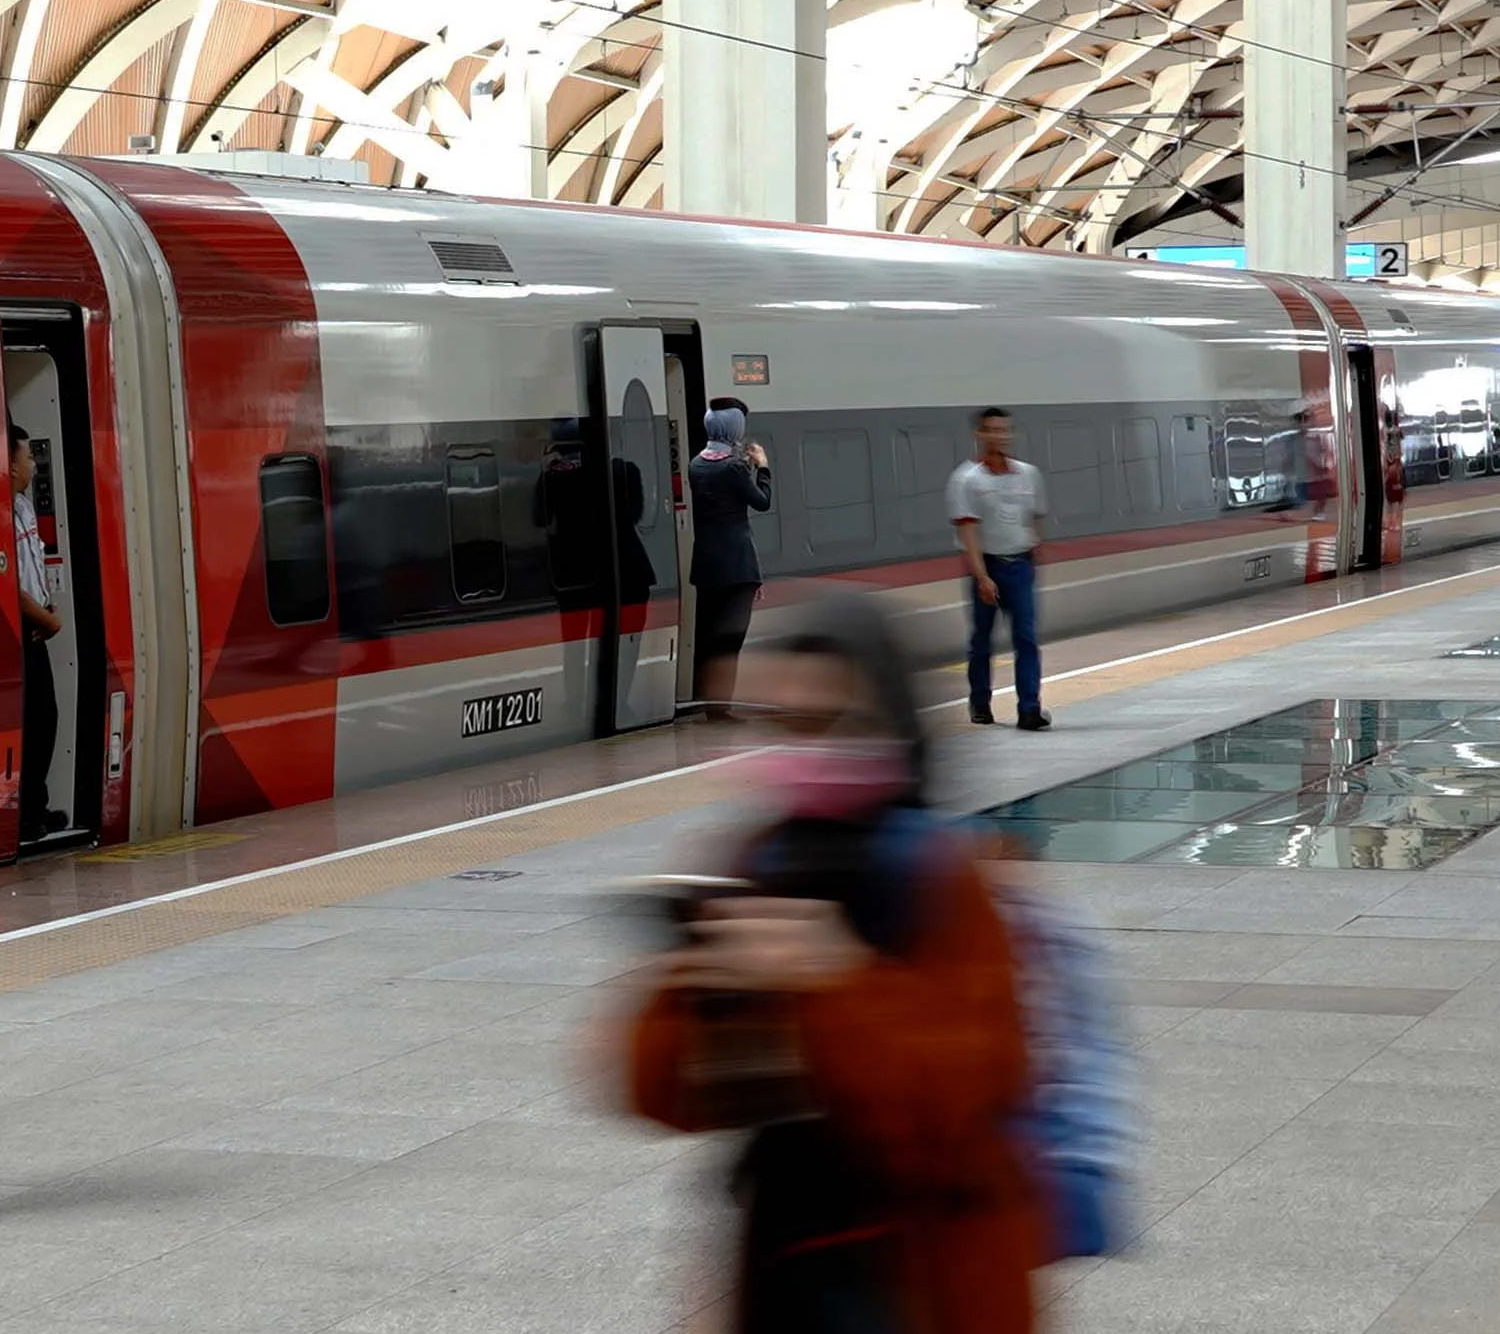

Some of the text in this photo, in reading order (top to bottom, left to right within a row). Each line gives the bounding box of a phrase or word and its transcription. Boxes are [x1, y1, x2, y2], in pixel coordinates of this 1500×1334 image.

[1381, 248, 1399, 272] 2
[506, 694, 524, 726] 22
[526, 691, 543, 723] 01
